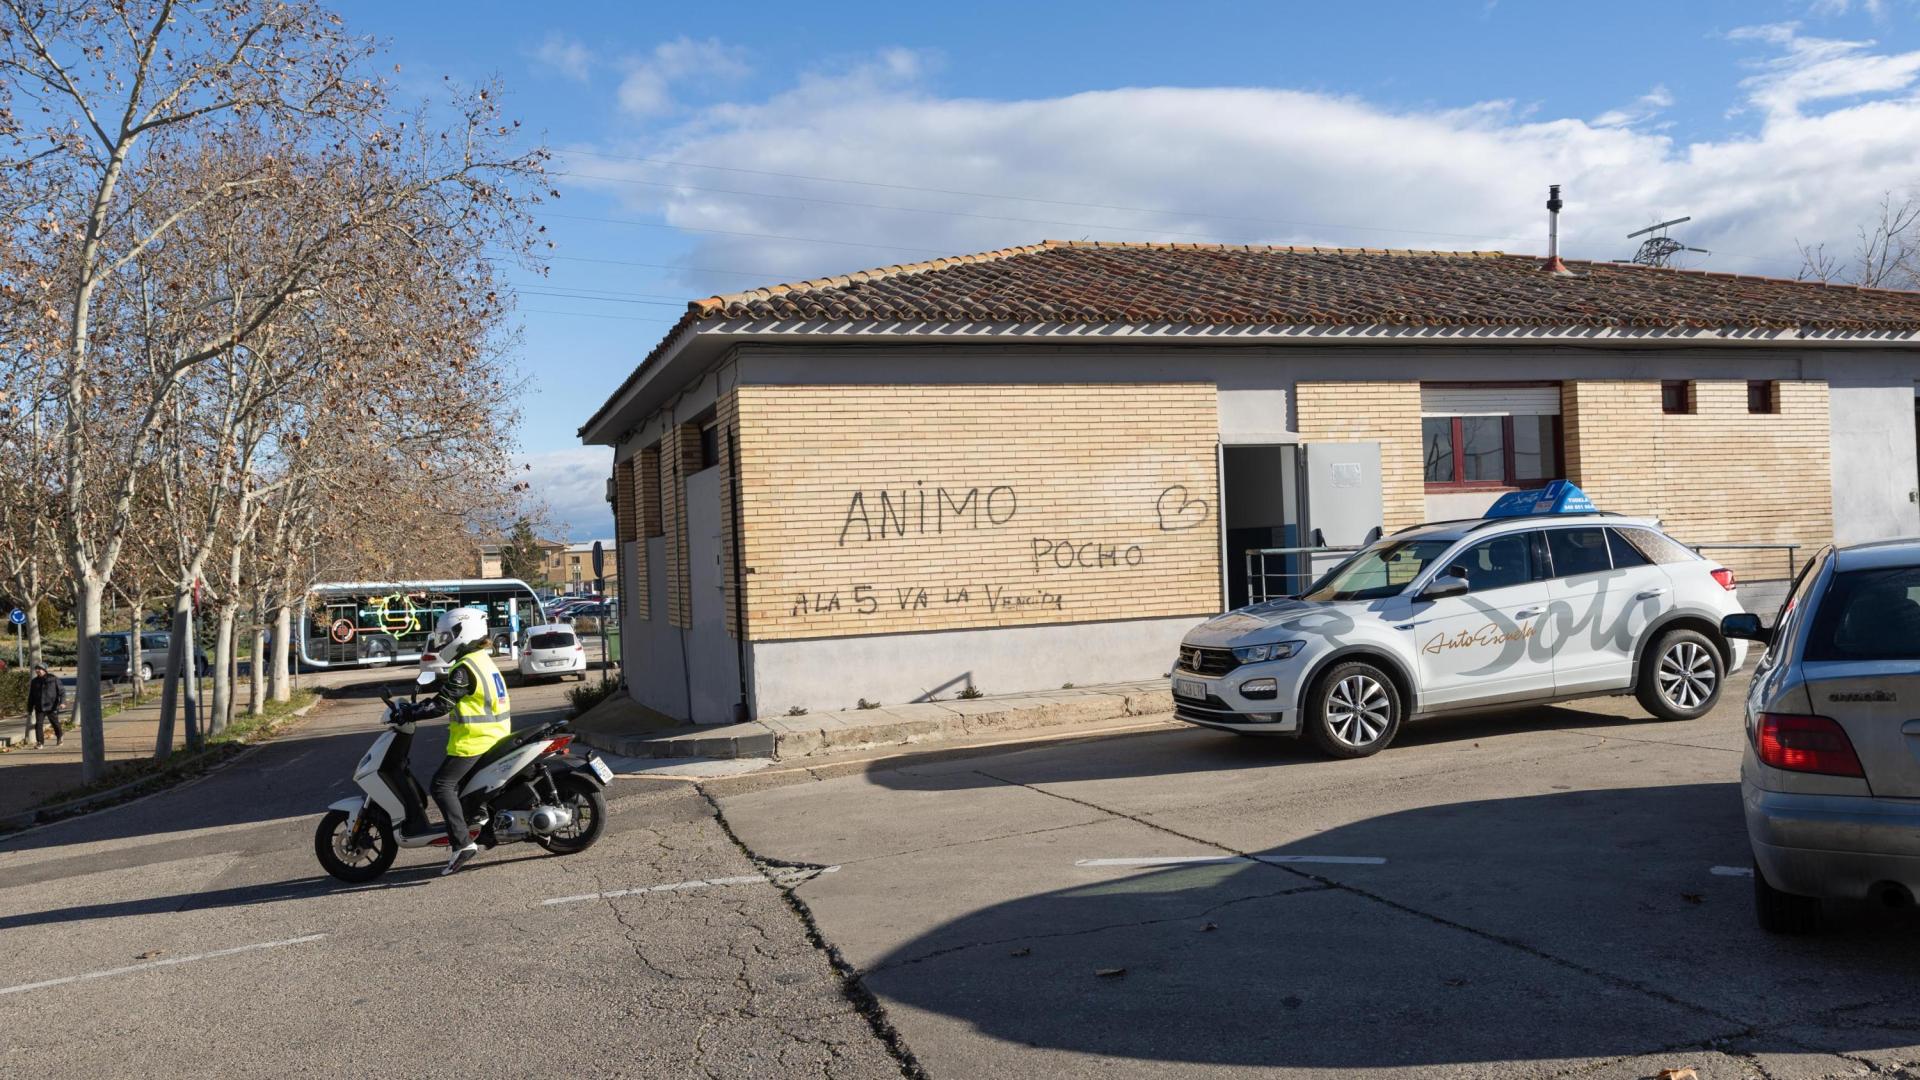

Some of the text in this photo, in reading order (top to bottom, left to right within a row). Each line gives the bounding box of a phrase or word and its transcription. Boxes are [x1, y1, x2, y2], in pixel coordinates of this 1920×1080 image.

[854, 585, 877, 614] 5
[897, 587, 928, 611] VA
[945, 587, 969, 604] LA
